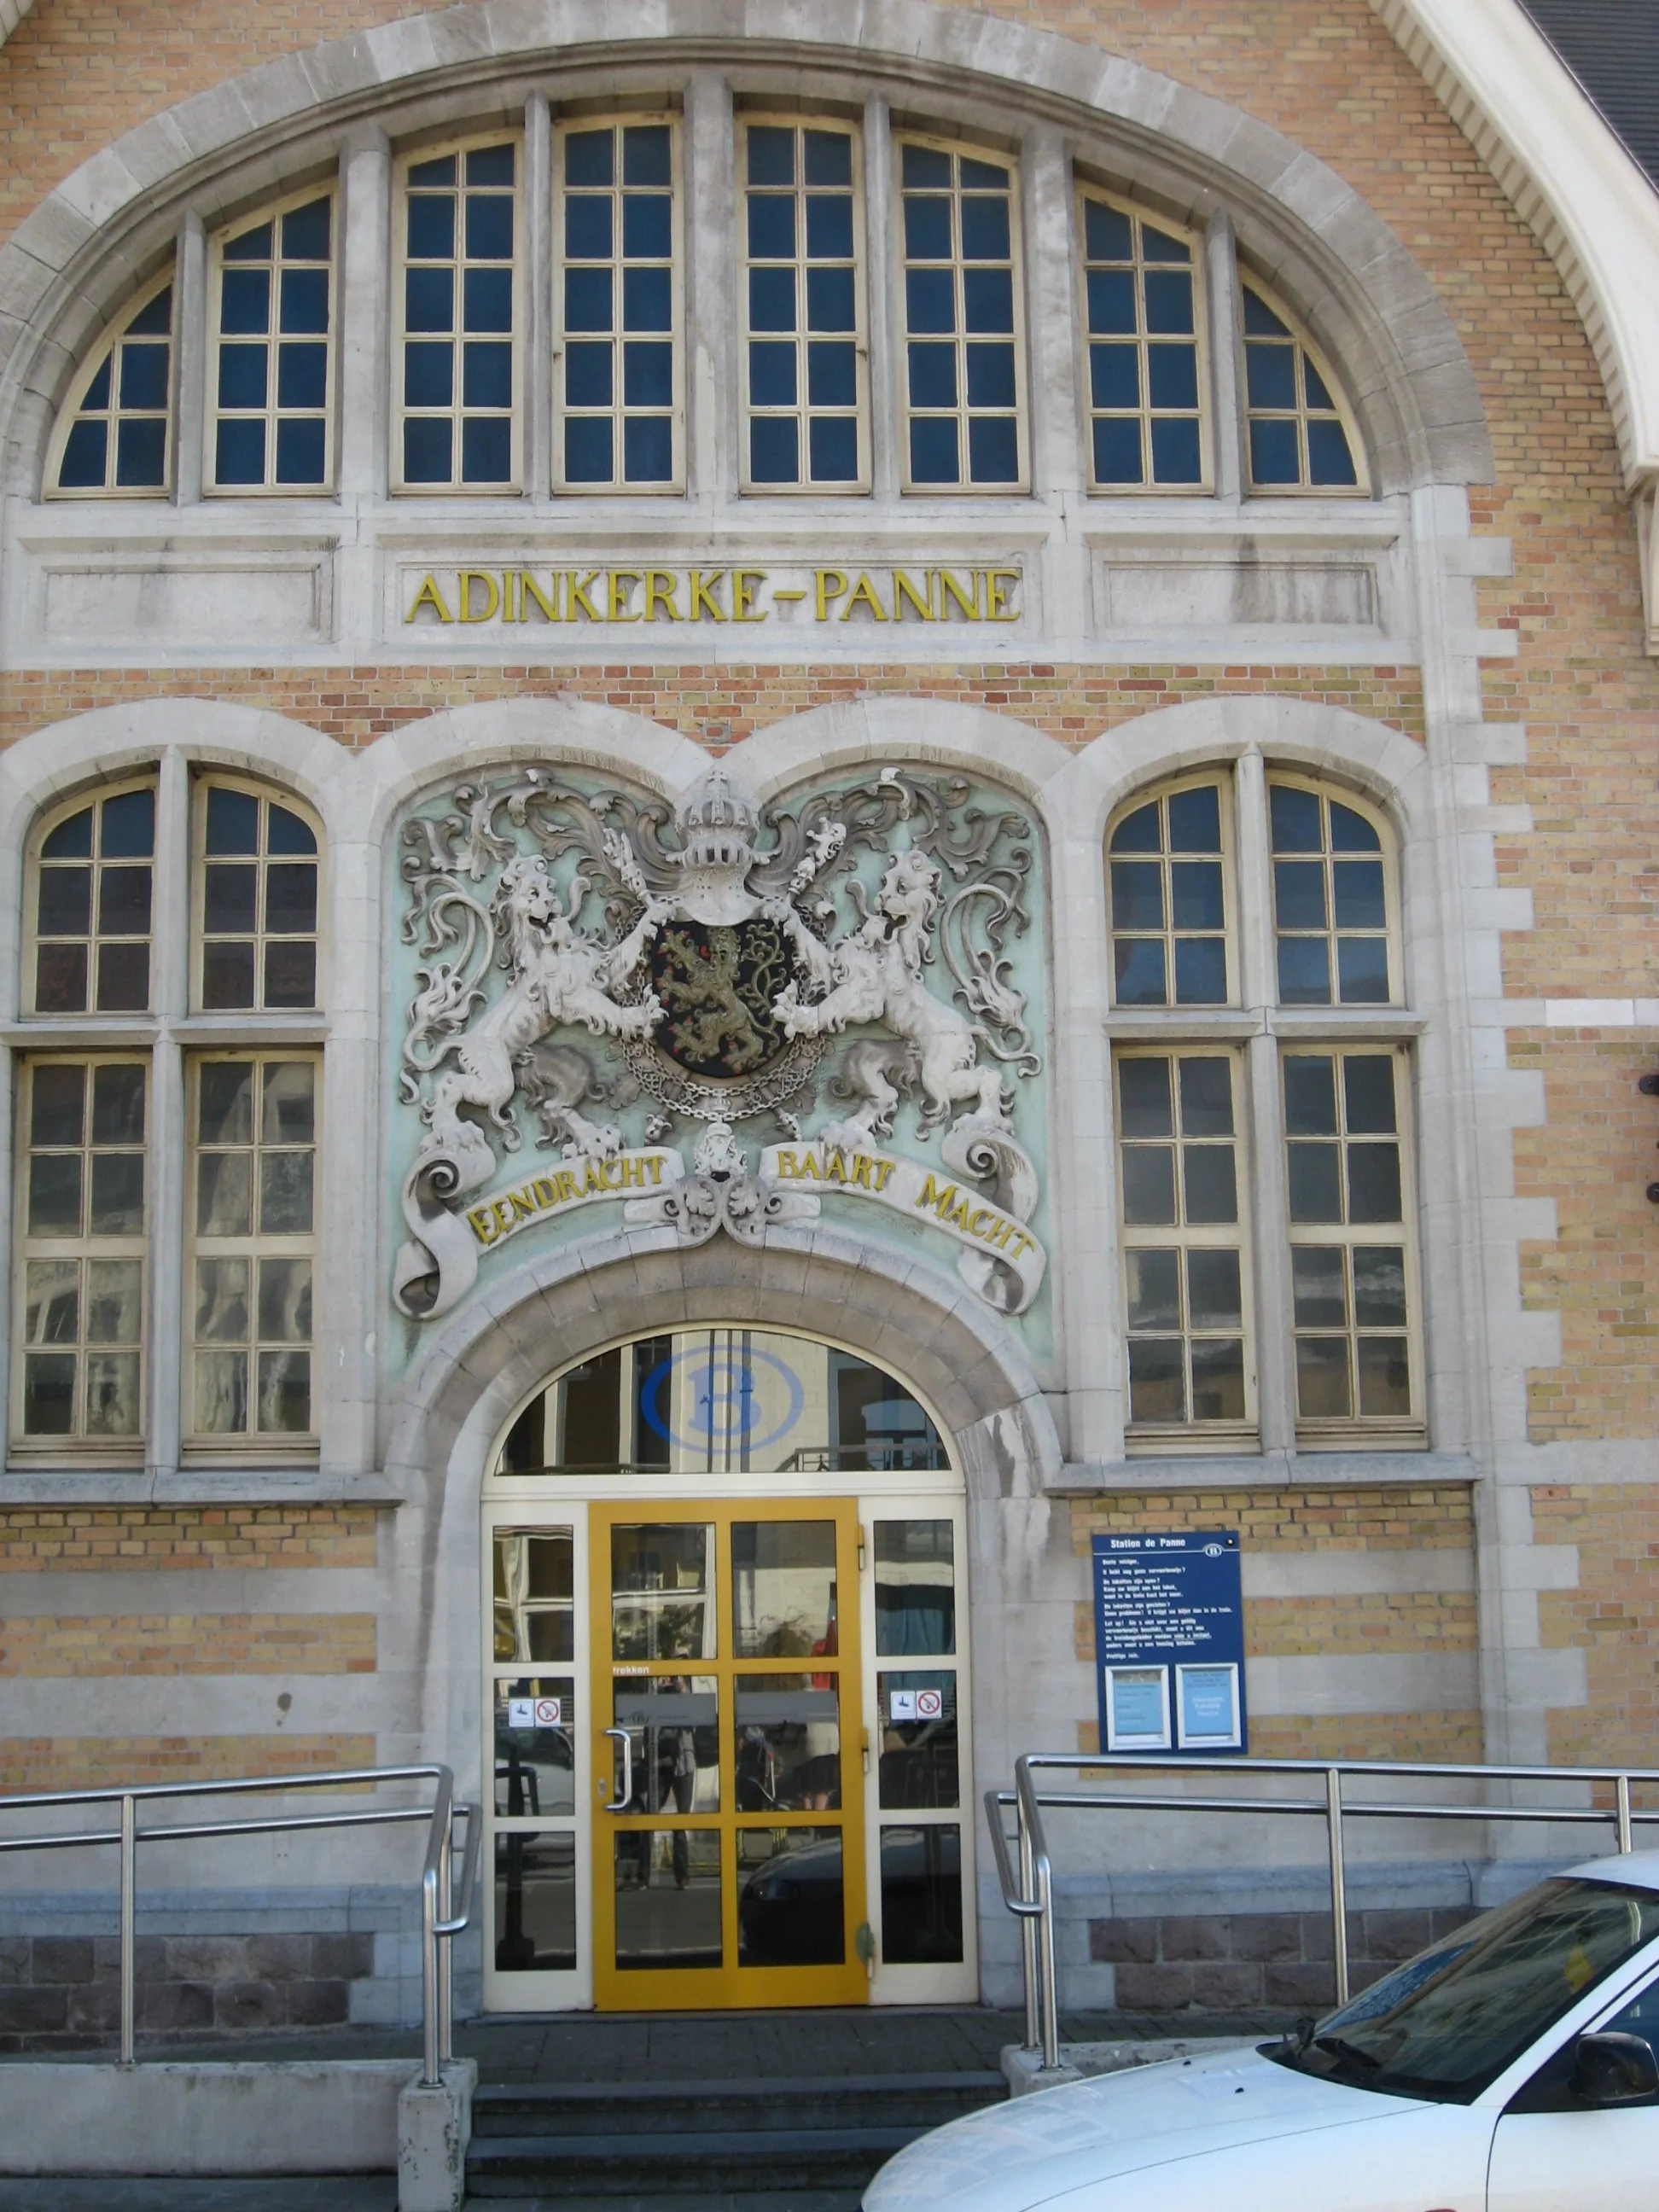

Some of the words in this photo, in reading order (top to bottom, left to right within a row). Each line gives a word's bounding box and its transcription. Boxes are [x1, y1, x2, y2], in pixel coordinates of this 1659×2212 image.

[467, 1154, 668, 1245] EENDRACHT
[777, 1150, 896, 1192] BAART
[914, 1173, 1035, 1261] MACHT
[688, 1362, 763, 1437] B
[1110, 1539, 1141, 1549] Station
[1145, 1539, 1155, 1548] de
[1160, 1537, 1185, 1547] Panne
